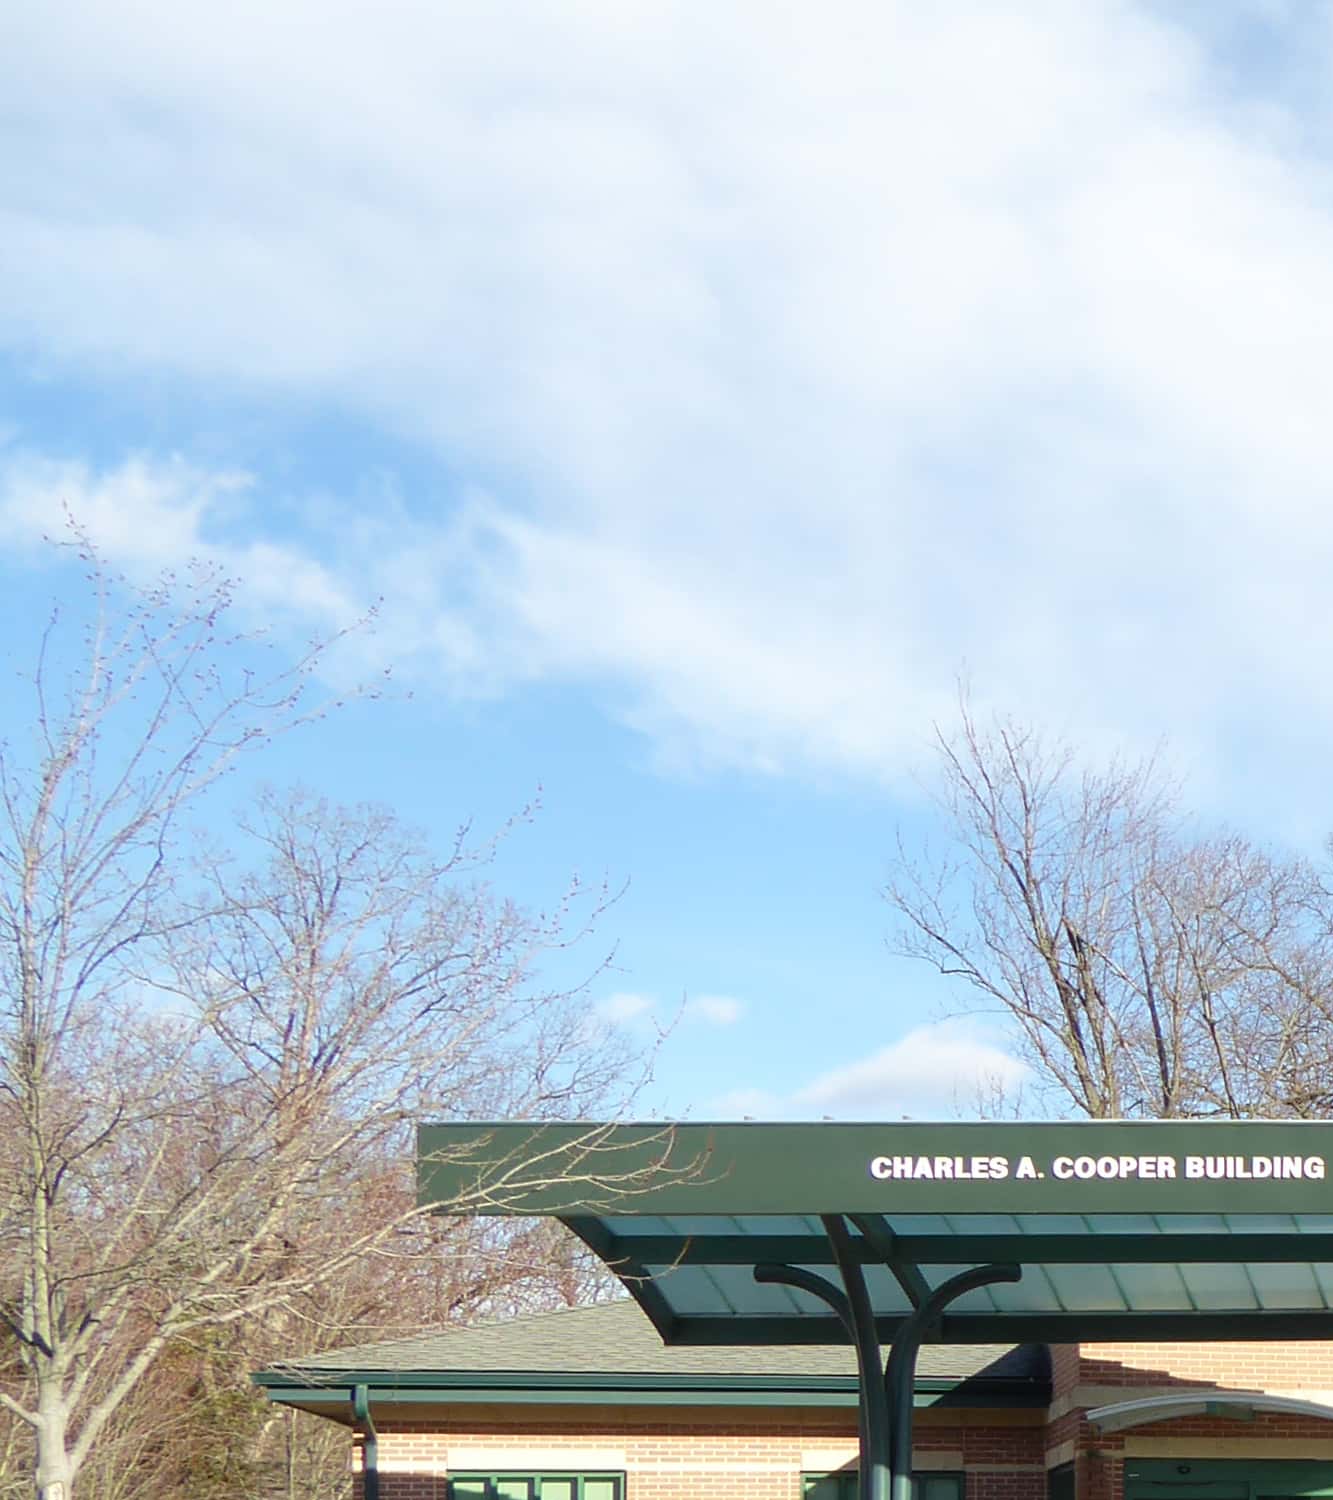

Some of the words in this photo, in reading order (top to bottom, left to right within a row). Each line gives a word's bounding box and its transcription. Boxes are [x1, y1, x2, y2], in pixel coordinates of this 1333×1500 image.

[869, 1156, 1009, 1179] CHARLES
[1015, 1156, 1045, 1179] A.
[1052, 1156, 1177, 1179] COOPER
[1185, 1156, 1325, 1179] BUILDING
